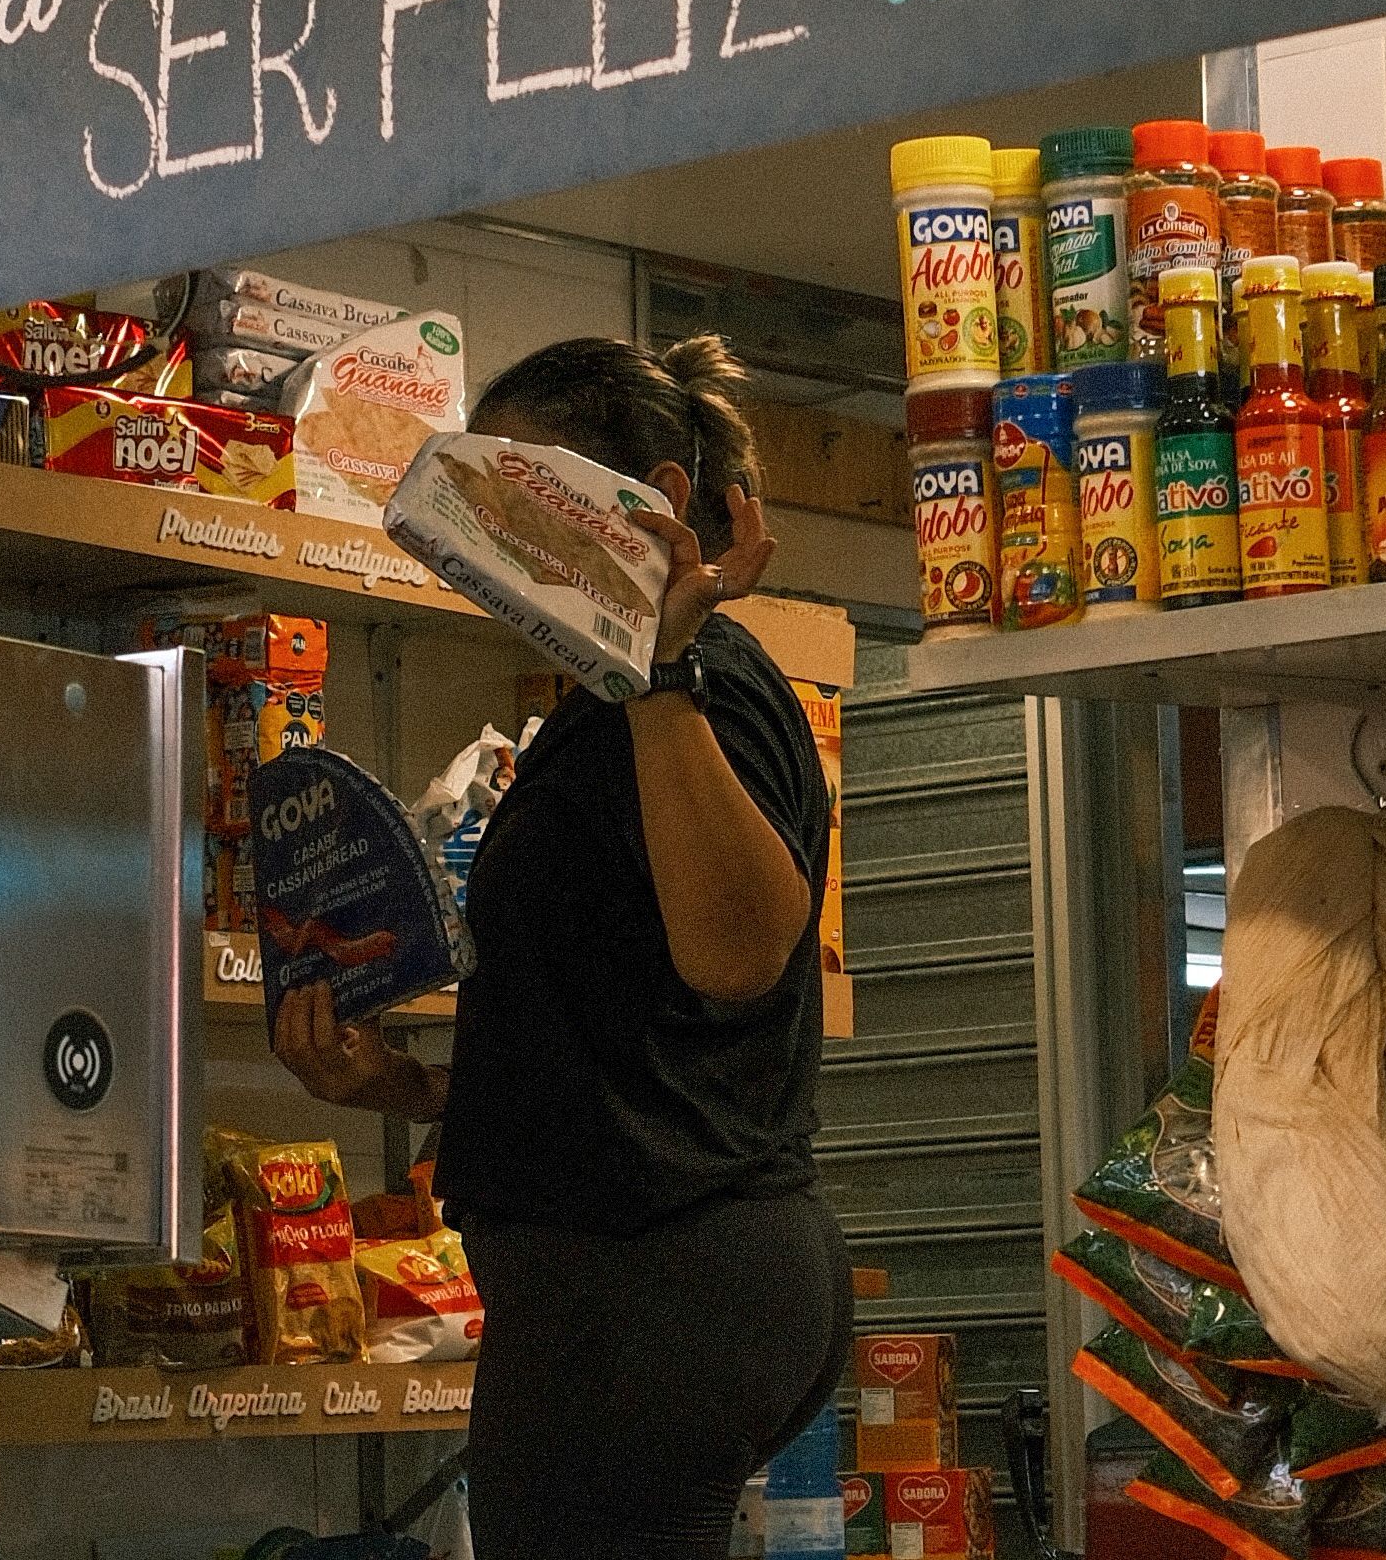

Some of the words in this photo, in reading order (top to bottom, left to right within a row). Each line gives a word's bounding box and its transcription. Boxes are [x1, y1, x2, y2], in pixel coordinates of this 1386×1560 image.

[913, 215, 989, 244] GOYA
[1141, 223, 1155, 240] La
[1156, 217, 1206, 239] Comadre
[912, 240, 993, 295] Adobo
[275, 288, 338, 318] Cassava
[273, 318, 336, 345] Cassava
[359, 346, 418, 374] Casabe
[114, 429, 198, 473] noel
[326, 448, 401, 481] Cassava
[160, 506, 285, 559] Productos
[475, 504, 568, 579] Cassava
[570, 567, 646, 632] Bread
[441, 557, 525, 627] Cassava
[529, 620, 599, 674] Bread
[874, 1351, 919, 1366] SABORA
[93, 1385, 173, 1424] Brasil
[187, 1383, 308, 1430] Argentina
[323, 1381, 382, 1416] Cuba
[903, 1486, 945, 1501] SABORA
